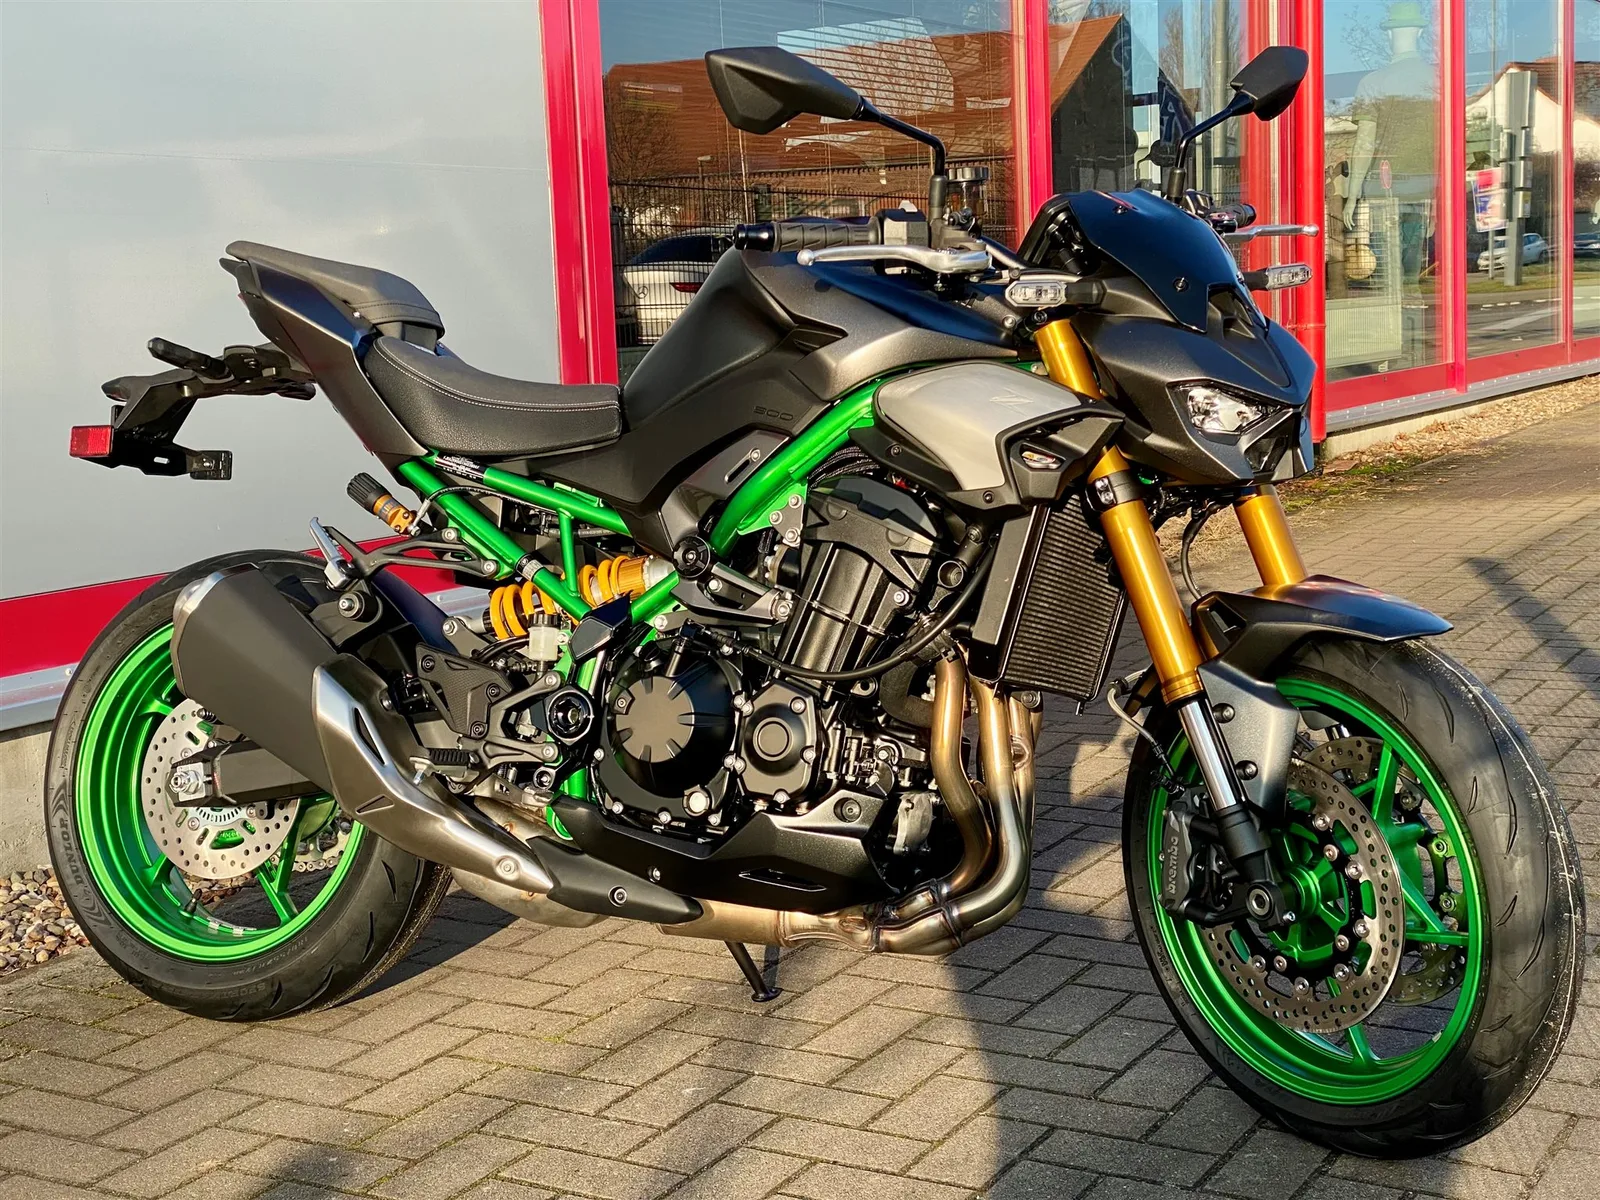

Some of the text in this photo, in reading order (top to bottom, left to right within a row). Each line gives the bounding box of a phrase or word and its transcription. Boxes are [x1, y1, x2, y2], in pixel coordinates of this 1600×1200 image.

[753, 405, 794, 421] 900
[59, 817, 84, 886] DUNLOP
[1166, 836, 1179, 895] brembo
